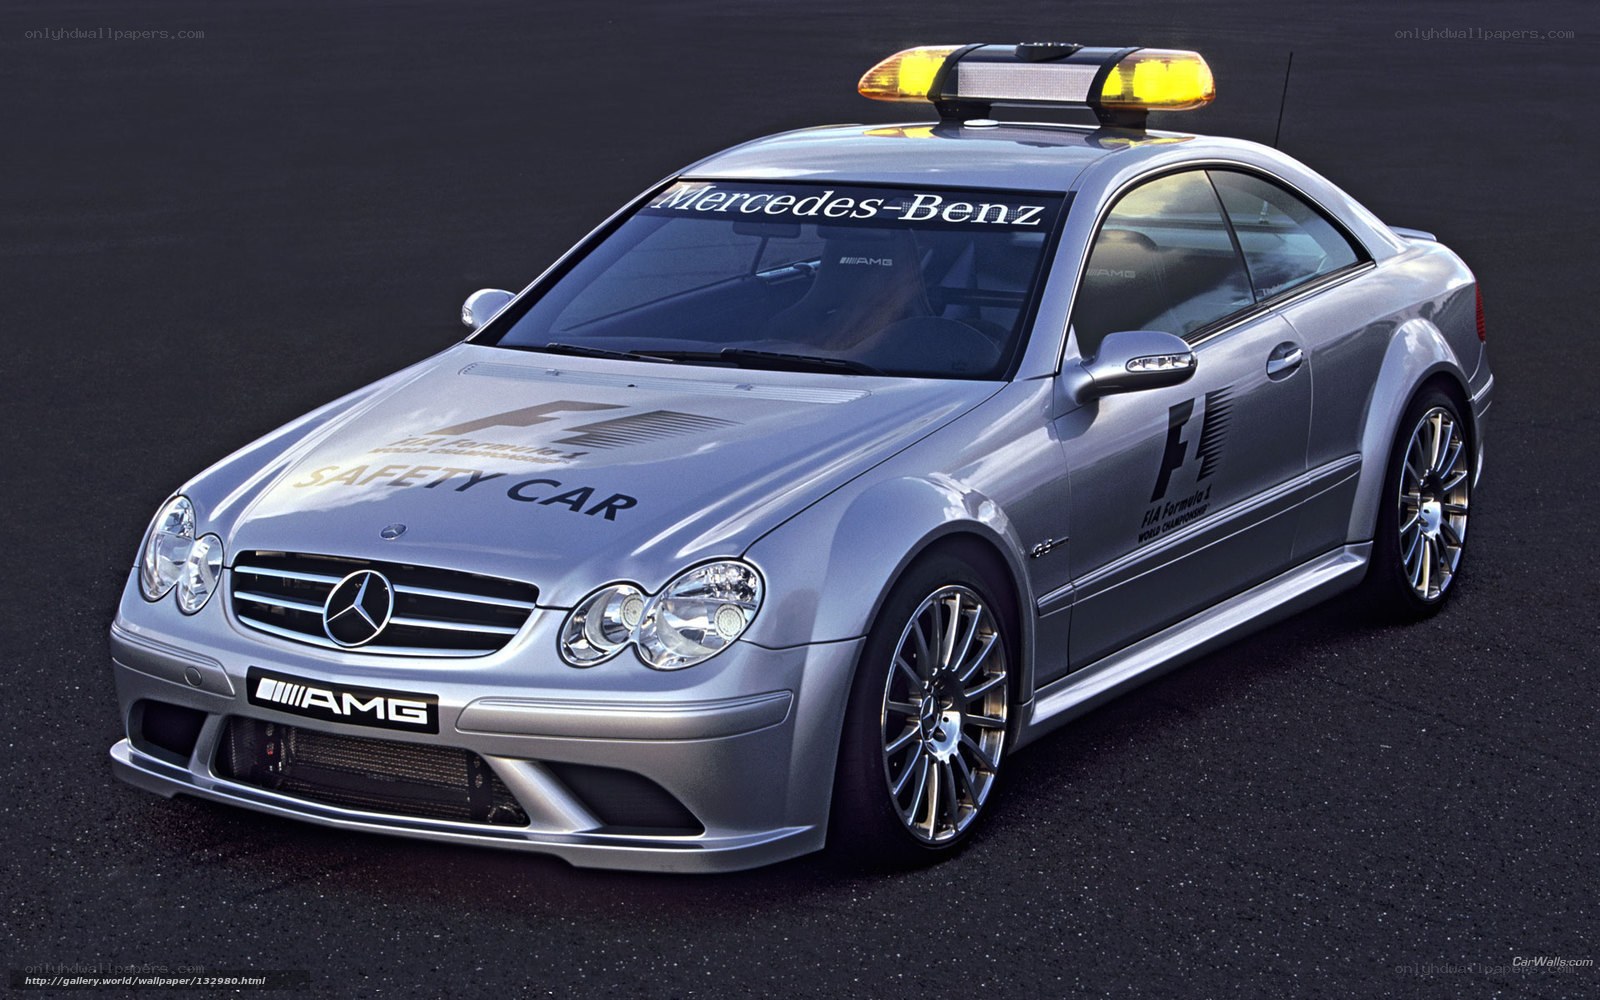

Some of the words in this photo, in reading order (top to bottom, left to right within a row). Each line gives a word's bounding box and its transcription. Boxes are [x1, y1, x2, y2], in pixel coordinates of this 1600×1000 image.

[651, 184, 1045, 226] Mercedes-Benz
[293, 464, 507, 493] SAFETY
[506, 478, 638, 522] CAR
[1141, 505, 1161, 529] FIA
